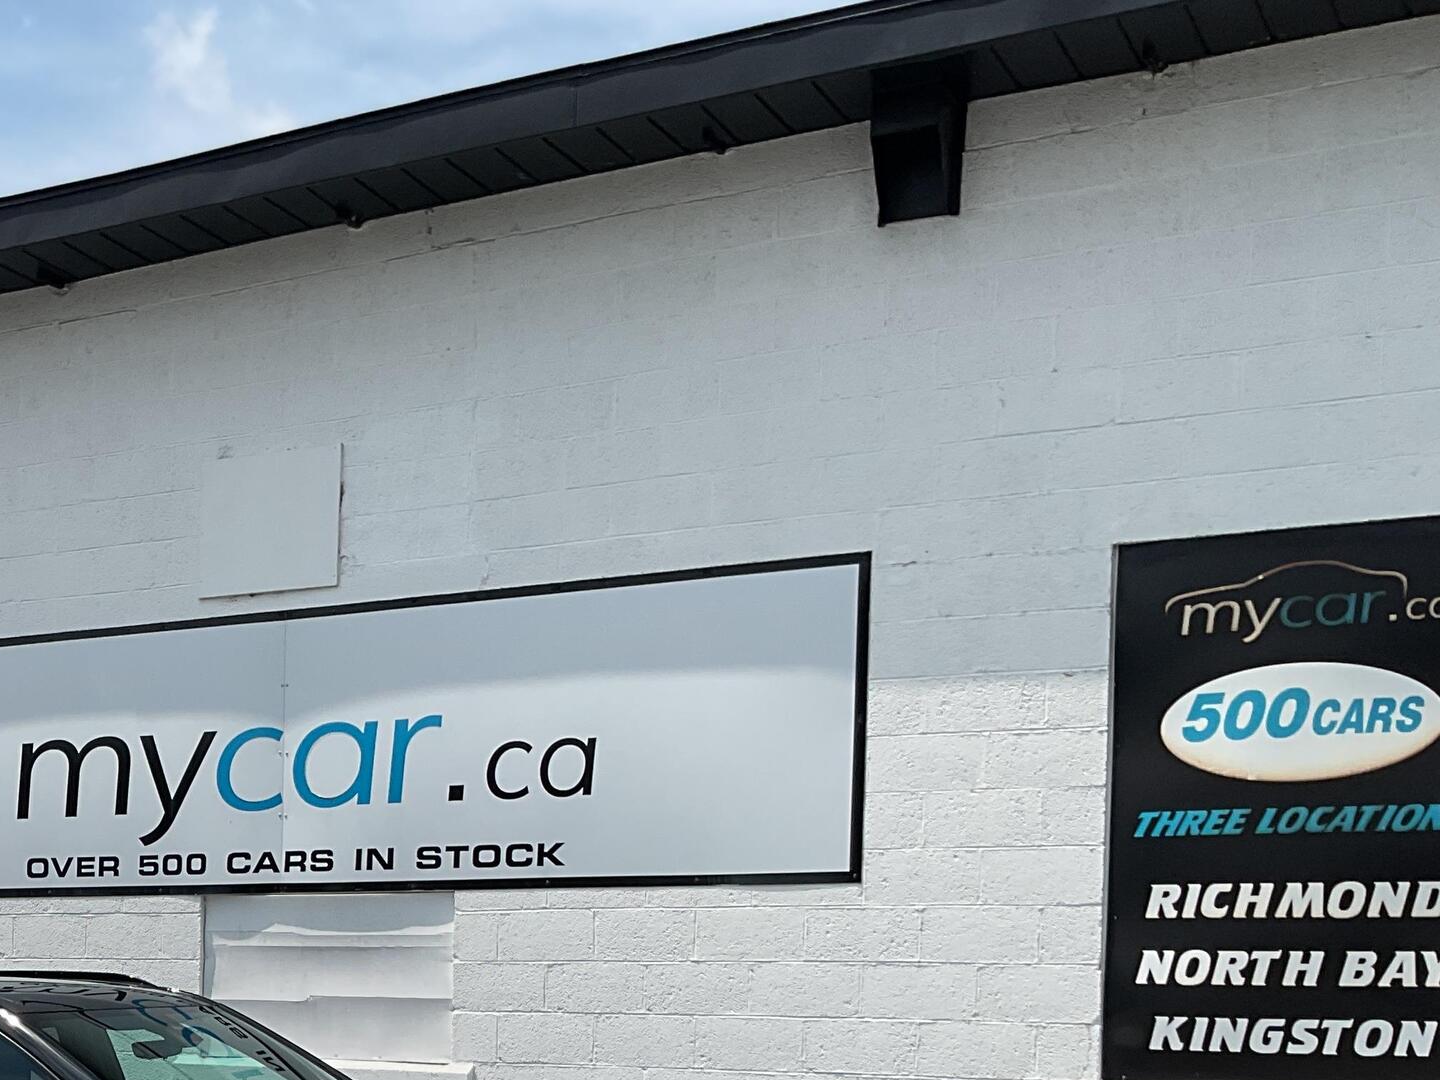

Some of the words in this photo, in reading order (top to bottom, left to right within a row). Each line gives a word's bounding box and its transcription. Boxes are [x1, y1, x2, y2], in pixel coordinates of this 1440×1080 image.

[16, 714, 598, 848] mycar.ca
[1133, 808, 1248, 838] THREE
[26, 856, 120, 880] OVER
[138, 854, 207, 877] 500
[226, 849, 334, 875] CARS
[355, 848, 395, 871] IN
[415, 842, 566, 870] STOCK
[1144, 880, 1440, 919] RICHMOND
[1134, 949, 1325, 988] NORTH
[1148, 1015, 1439, 1058] KINGSTON
